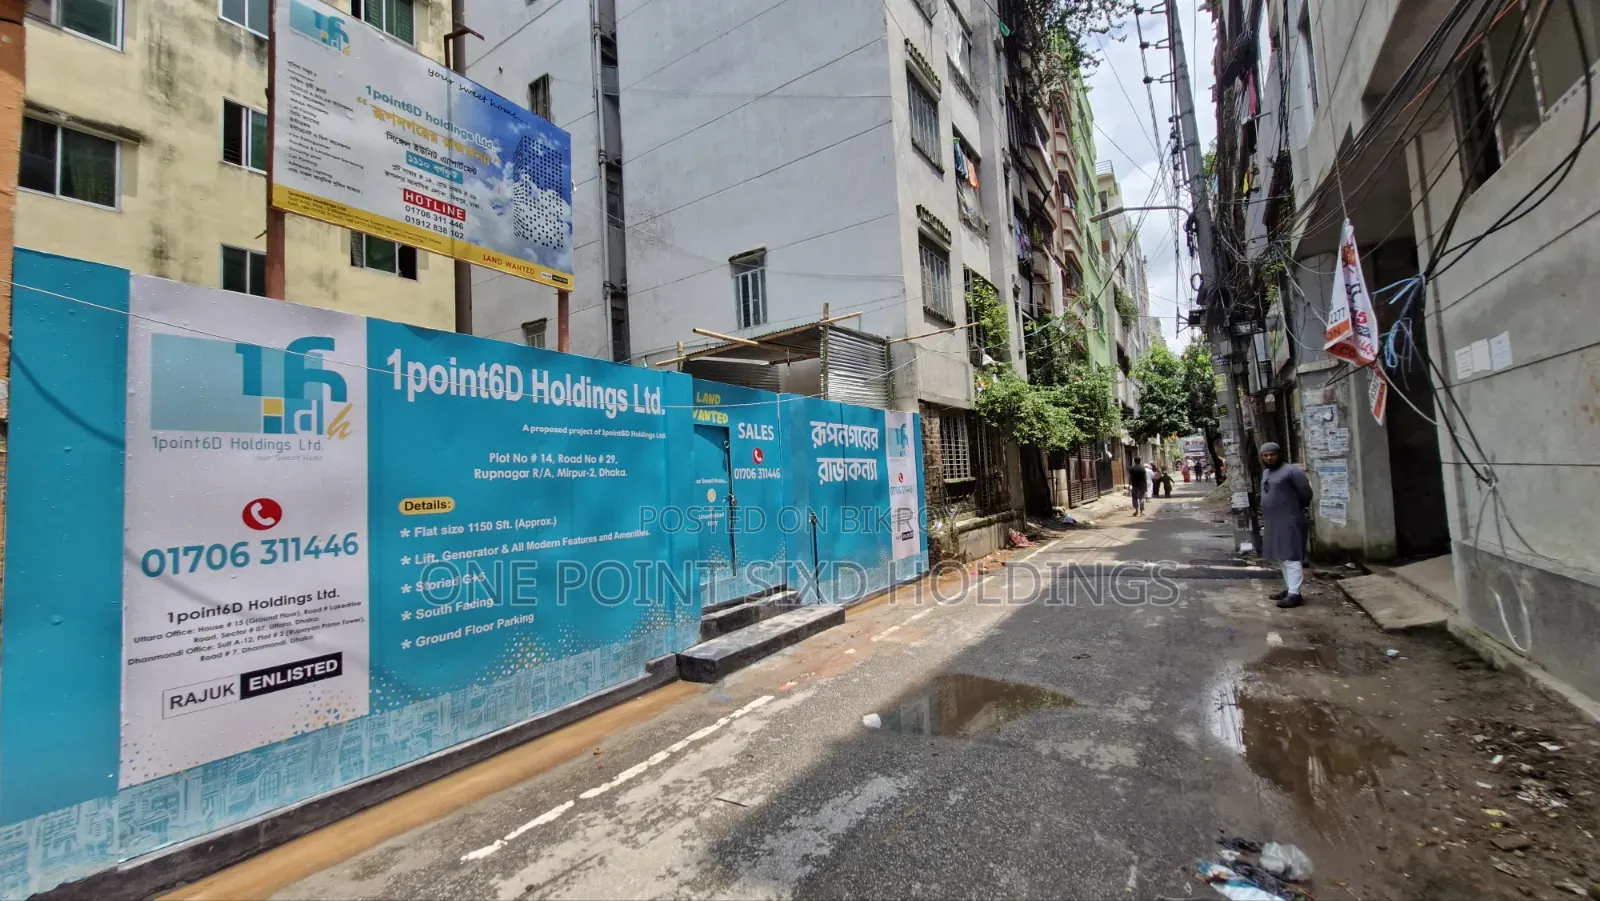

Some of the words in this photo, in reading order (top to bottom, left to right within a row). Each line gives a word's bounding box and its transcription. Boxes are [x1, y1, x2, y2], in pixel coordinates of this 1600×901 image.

[428, 68, 455, 85] your
[458, 84, 488, 103] sweet
[365, 85, 422, 117] 1point6D
[426, 111, 474, 141] holdings
[405, 191, 464, 219] HOTLINE
[405, 204, 431, 219] 01706
[433, 213, 447, 224] 311
[449, 219, 464, 230] 446
[405, 215, 431, 229] 01912
[432, 224, 448, 235] 838
[451, 229, 464, 240] 102
[483, 254, 503, 265] LAND
[505, 260, 535, 275] WANTED
[386, 348, 523, 403] 1point6D
[531, 368, 628, 419] Holdings
[633, 383, 666, 415] Ltd.
[696, 391, 721, 405] LAND
[152, 435, 222, 452] 1point6D
[230, 437, 291, 453] Holdings
[299, 439, 324, 451] Ltd.
[522, 424, 529, 432] A
[530, 425, 568, 434] proposed
[569, 427, 593, 437] project
[602, 429, 630, 438] 1point6D
[631, 431, 655, 441] Holdings
[738, 422, 775, 441] SALES
[809, 420, 879, 451] রূপনগরের
[489, 452, 510, 464] Plot
[512, 452, 528, 464] No
[530, 453, 538, 464] #
[541, 453, 556, 465] 14,
[558, 453, 582, 464] Road
[584, 454, 597, 464] No
[605, 454, 618, 465] 29,
[816, 457, 877, 486] রাজকন্যা
[474, 468, 529, 481] Rupnagar
[532, 468, 555, 479] R/A,
[557, 467, 597, 480] Mirpur-2,
[598, 467, 628, 477] Dhaka.
[734, 467, 757, 480] 01706
[758, 467, 781, 480] 311446
[404, 499, 451, 511] Details:
[414, 526, 438, 537] Flat
[441, 524, 464, 535] size
[468, 521, 493, 533] 1150
[495, 519, 512, 530] Sft.
[515, 516, 557, 531] (Approx.)
[141, 541, 250, 578] 01706
[260, 532, 359, 565] 311446
[442, 547, 499, 561] Generator
[501, 544, 510, 554] &
[511, 542, 524, 553] All
[526, 539, 561, 552] Modern
[562, 534, 598, 546] Features
[599, 532, 613, 541] and
[415, 577, 460, 592] Storied
[167, 602, 243, 625] 1point6D
[248, 593, 313, 611] Holdings
[317, 588, 340, 601] Ltd.
[415, 603, 452, 620] South
[455, 597, 494, 612] Facing
[133, 633, 163, 643] Uttara
[165, 628, 196, 638] Office:
[198, 623, 224, 633] House
[235, 619, 243, 627] 15
[245, 614, 278, 626] (Ground
[304, 607, 322, 615] Road
[329, 601, 362, 611] Lakedrive
[221, 629, 246, 639] Sector
[416, 628, 462, 647] Ground
[465, 622, 495, 637] Floor
[497, 613, 534, 629] Parking
[128, 649, 184, 666] Dhanmondi
[185, 644, 216, 655] Office:
[257, 633, 271, 641] Plot
[285, 624, 320, 637] (Rupayan
[321, 621, 341, 629] Prime
[200, 652, 223, 662] Road
[289, 635, 314, 644] Dhaka
[169, 680, 236, 710] RAJUK
[248, 659, 339, 692] ENLISTED
